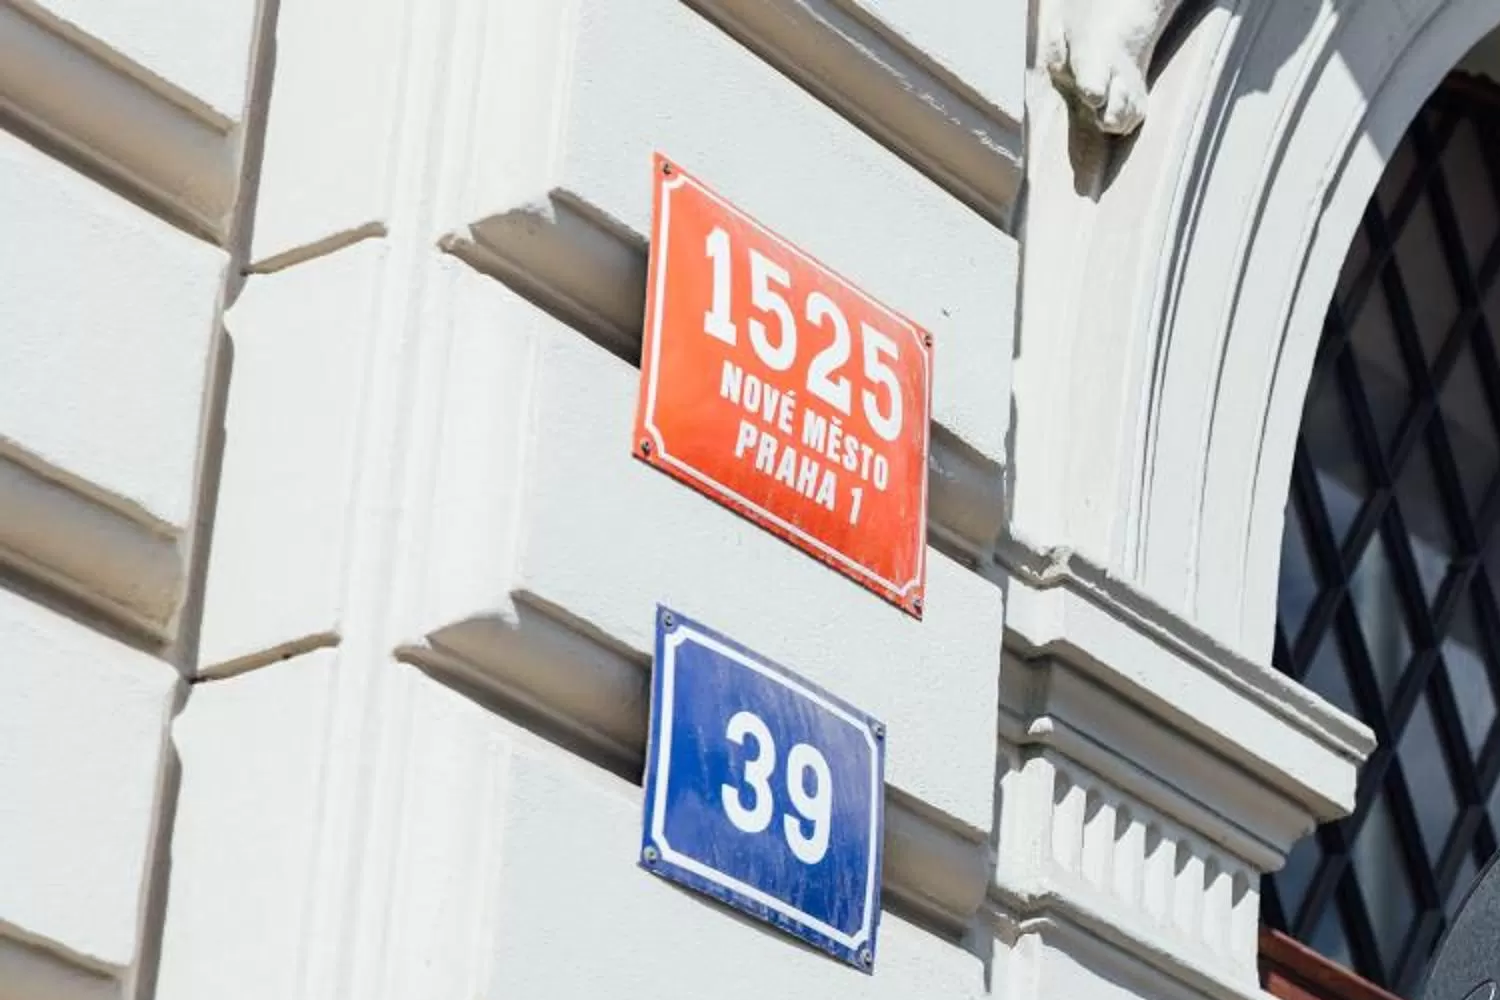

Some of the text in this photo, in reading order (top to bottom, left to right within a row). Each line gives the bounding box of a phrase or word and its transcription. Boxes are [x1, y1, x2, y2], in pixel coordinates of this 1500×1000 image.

[703, 226, 903, 442] 1525
[719, 359, 889, 492] NOVÉ MĚSTO
[735, 420, 864, 526] PRAHA 1
[720, 709, 834, 865] 39
